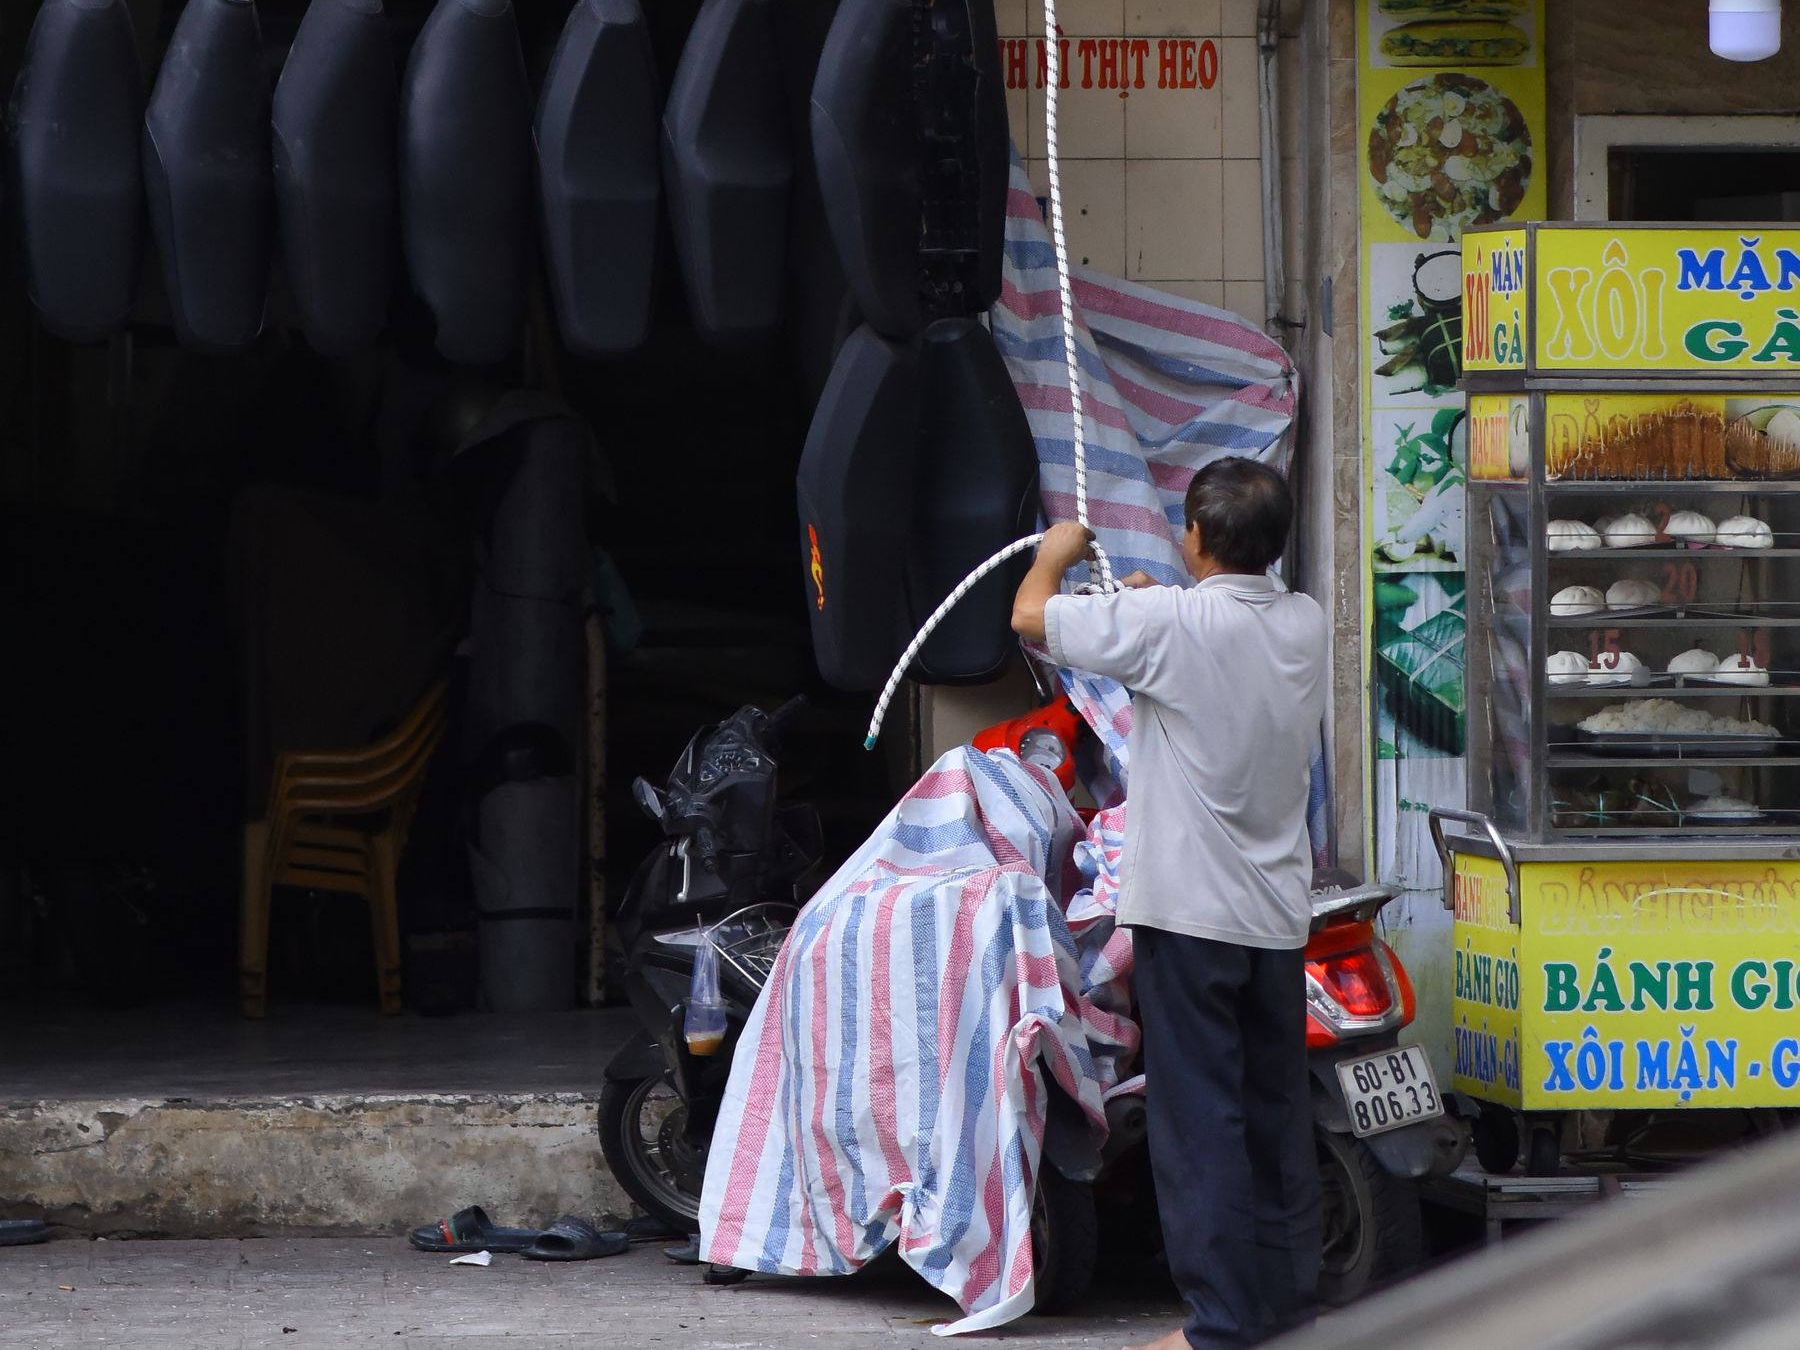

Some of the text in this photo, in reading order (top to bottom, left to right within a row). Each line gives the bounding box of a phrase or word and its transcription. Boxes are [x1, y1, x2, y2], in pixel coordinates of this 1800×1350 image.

[1077, 39, 1149, 99] THỊT
[1157, 39, 1218, 89] HEO
[1466, 238, 1524, 361] XÔI MẶN
[1546, 238, 1667, 361] XÔI
[1493, 310, 1524, 365] GÀ
[1684, 308, 1800, 363] GÀ
[1588, 628, 1621, 669] 15
[1455, 859, 1483, 925] BÁNH
[1456, 938, 1520, 1011] BÁNH GIÒ
[1543, 947, 1800, 1012] BÁNH GI
[1352, 1051, 1417, 1094] 60-B1
[1455, 1015, 1473, 1075] XÔI
[1474, 1020, 1497, 1091] MẶN
[1504, 1025, 1520, 1091] GÀ
[1543, 1025, 1625, 1091] XÔI
[1636, 1024, 1738, 1102] MẶN
[1354, 1081, 1436, 1130] 806.33
